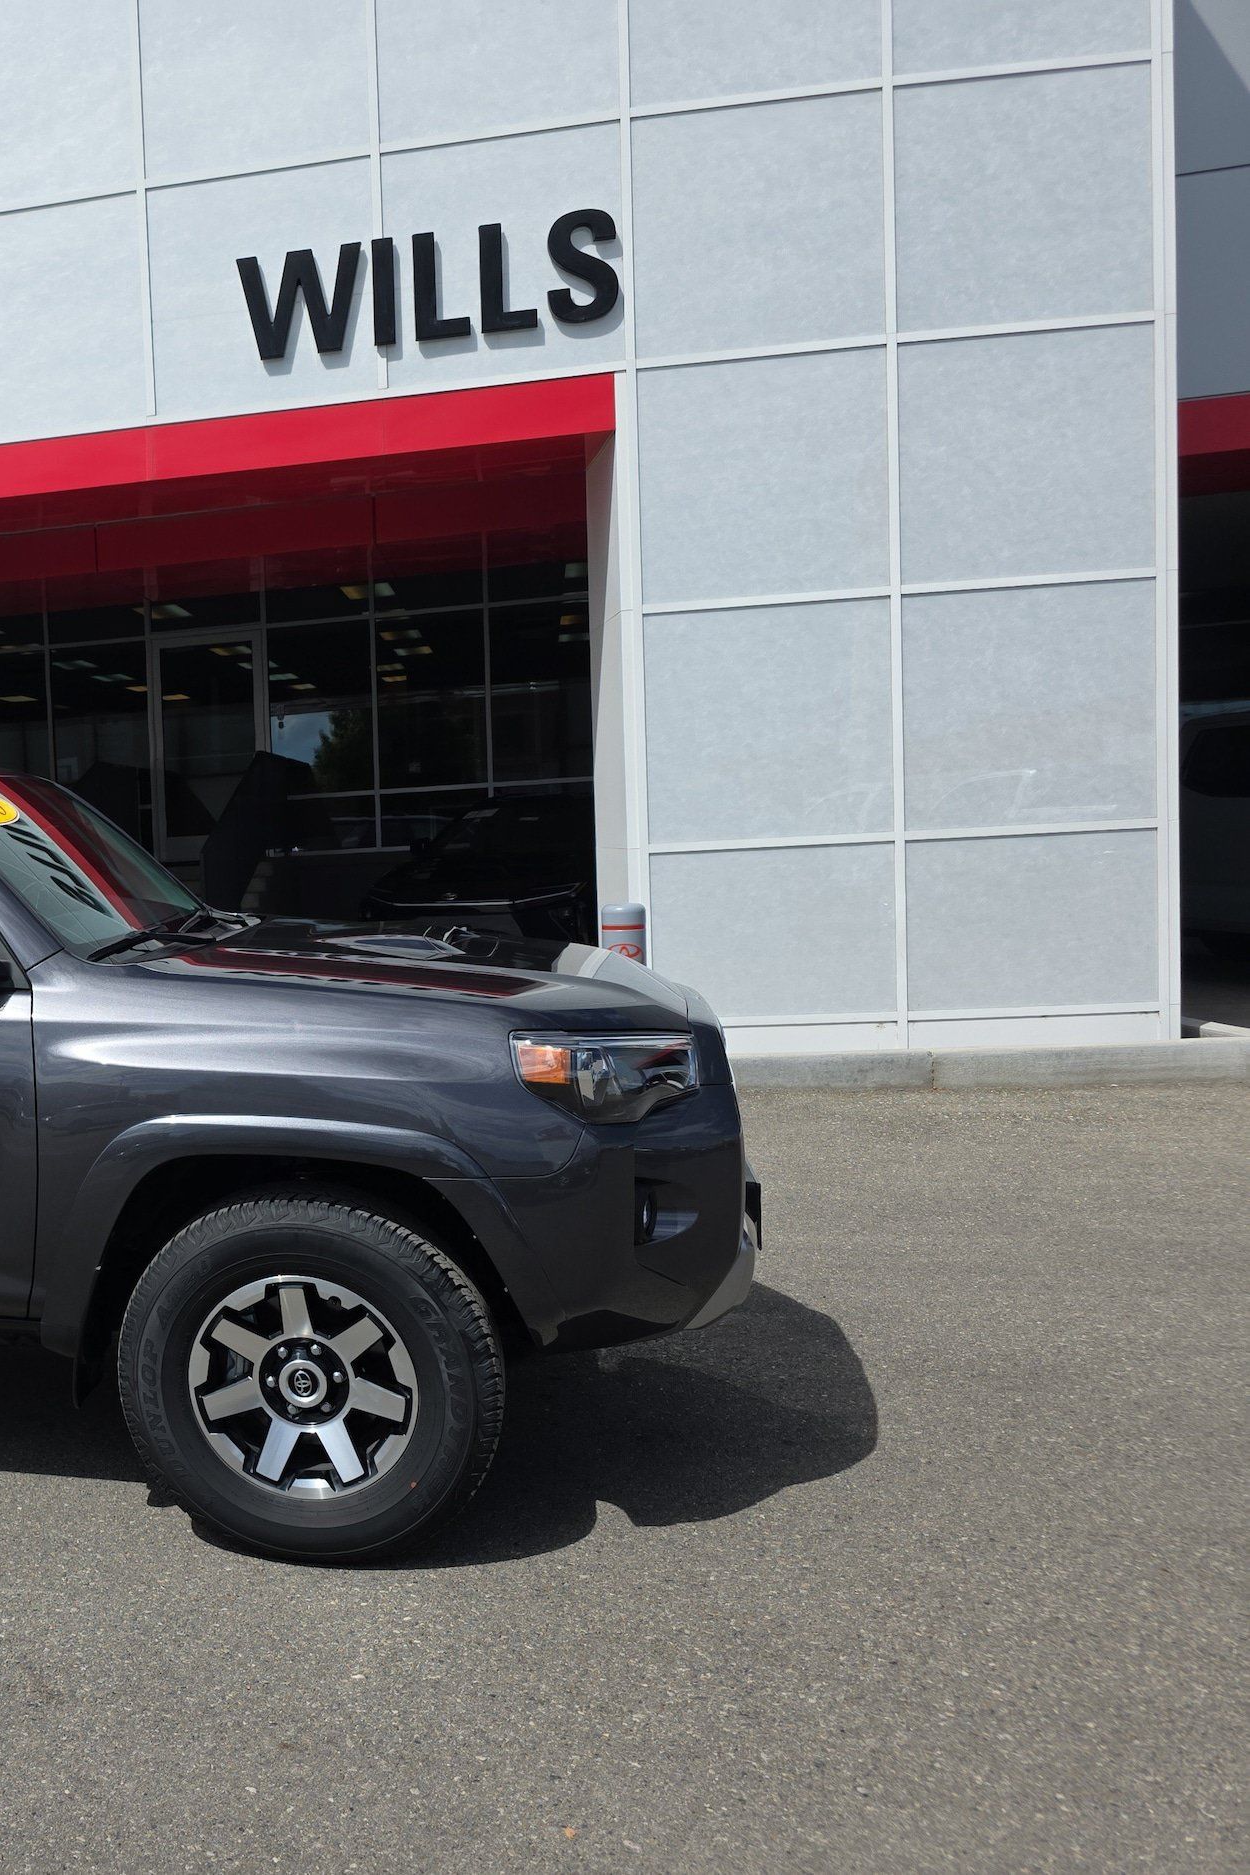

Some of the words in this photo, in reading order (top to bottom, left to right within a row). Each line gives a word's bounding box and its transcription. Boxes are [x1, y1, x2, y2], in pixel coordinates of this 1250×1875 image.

[235, 208, 620, 361] WILLS
[139, 1336, 189, 1478] DUNLOP
[406, 1296, 470, 1516] GRANDTREK
